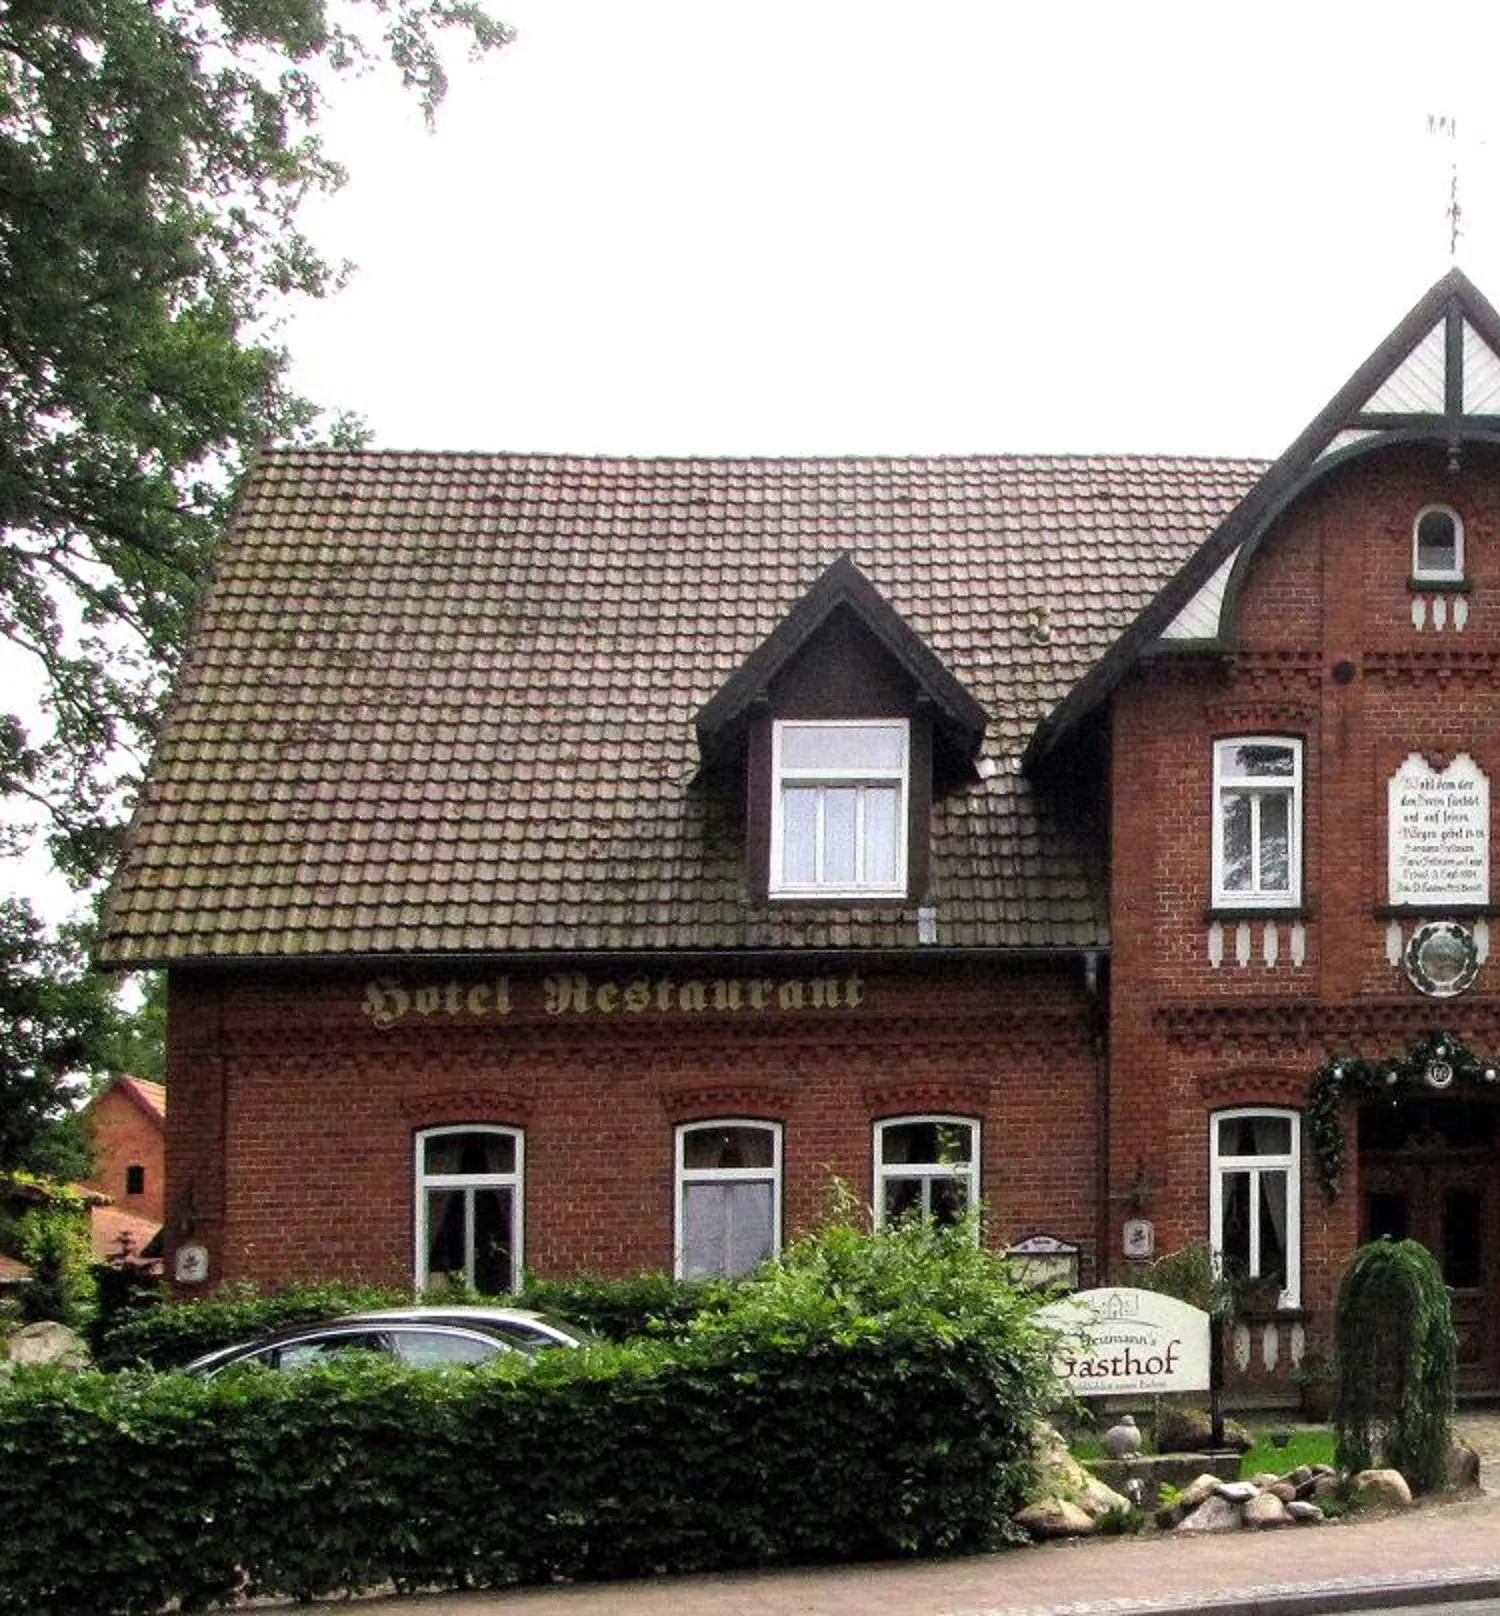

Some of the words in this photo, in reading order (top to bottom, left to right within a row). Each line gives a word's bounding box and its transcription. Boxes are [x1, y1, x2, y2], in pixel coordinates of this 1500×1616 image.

[361, 974, 512, 1030] Hotel
[544, 972, 865, 1014] Restaurant
[1053, 1340, 1181, 1379] Gasthof
